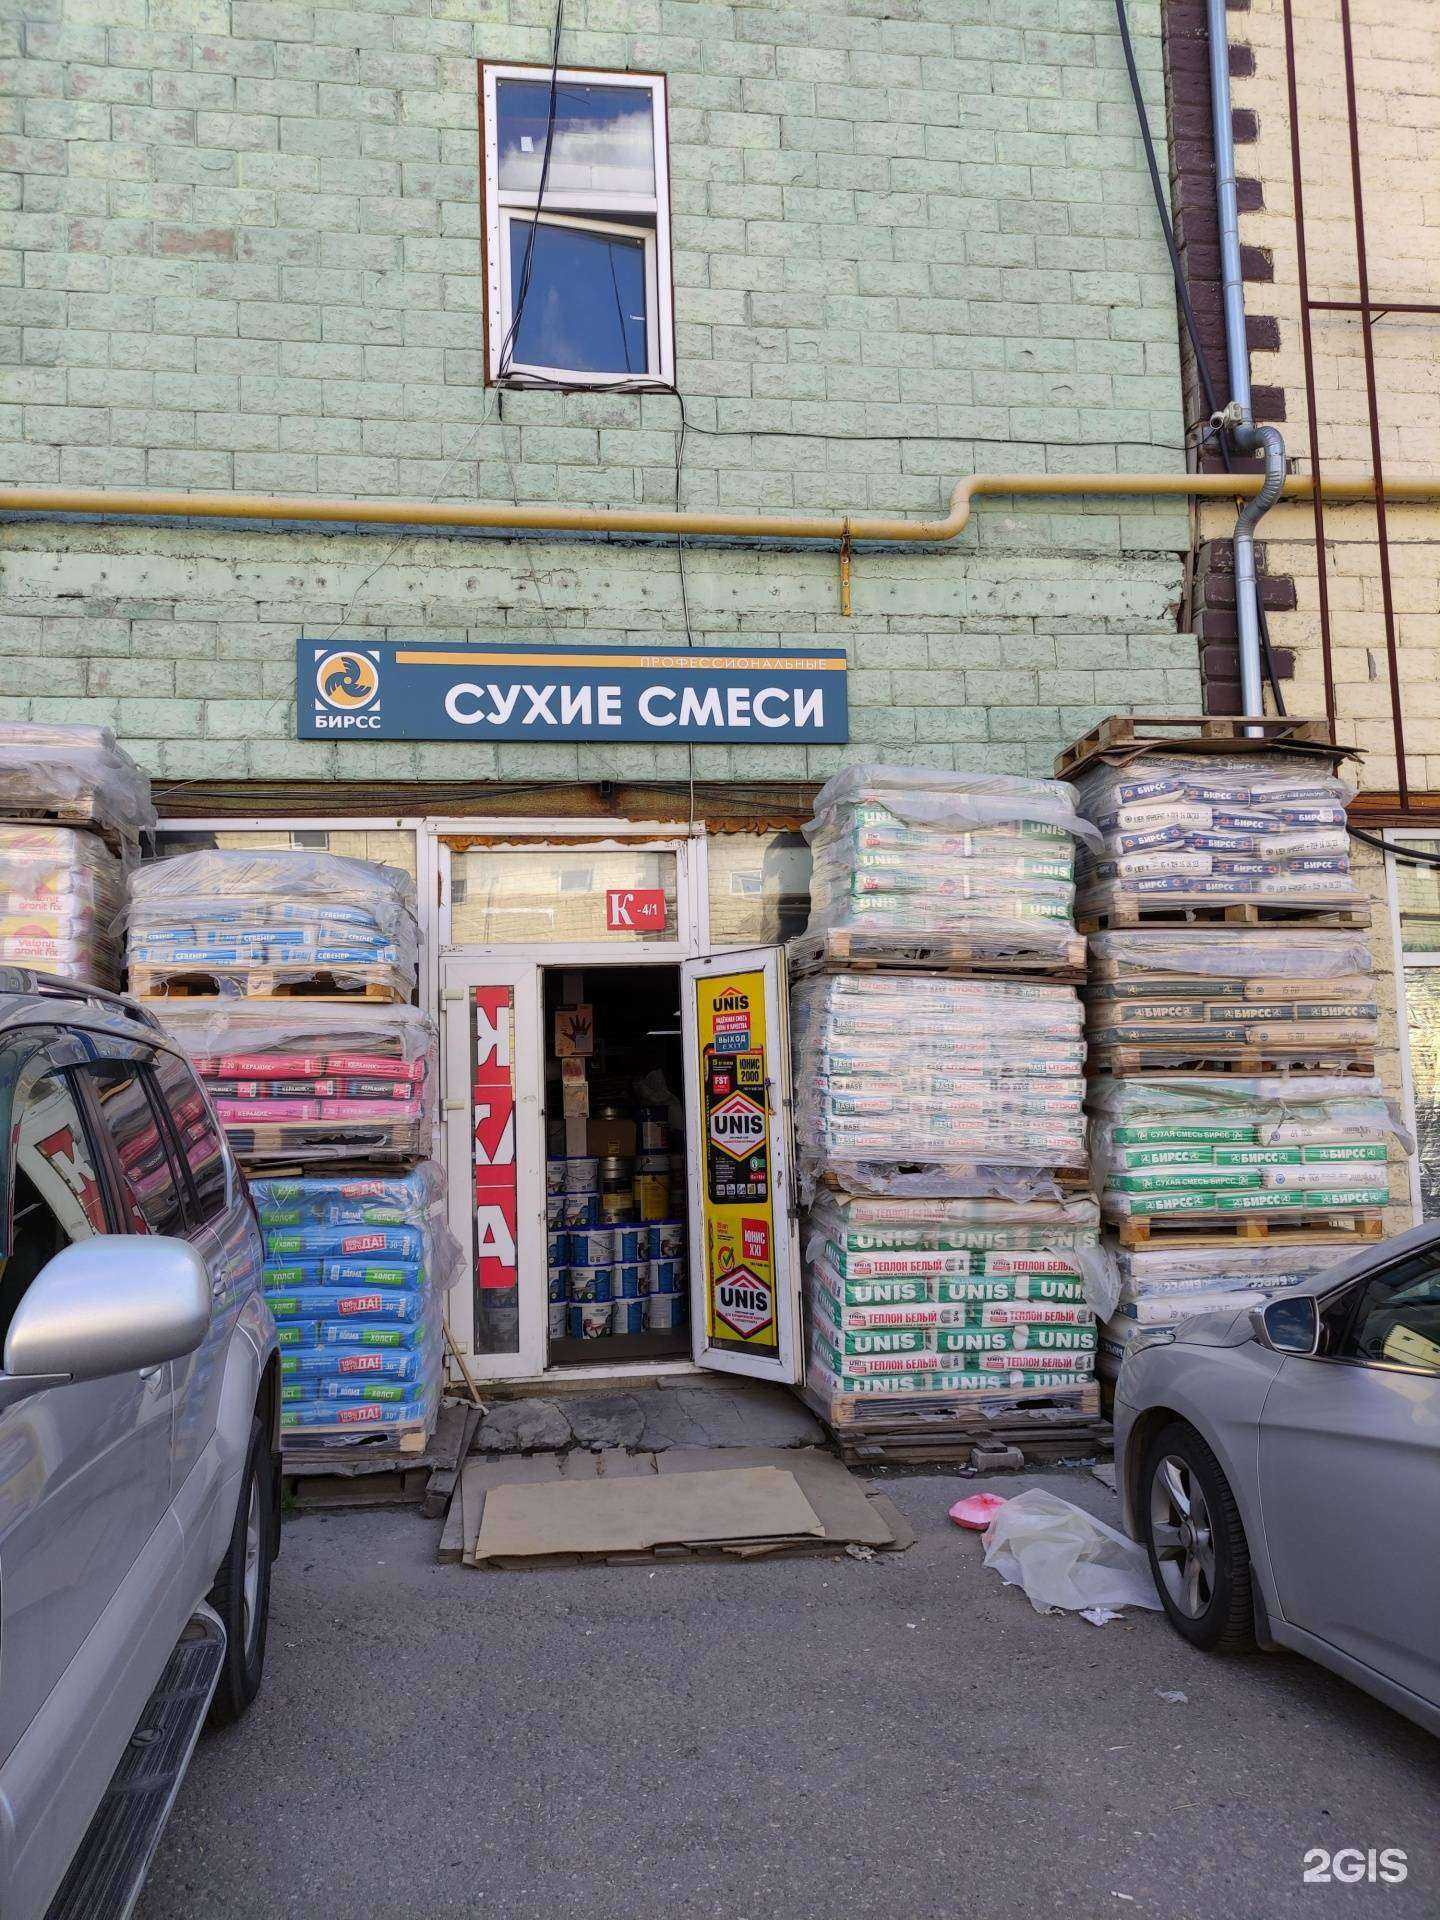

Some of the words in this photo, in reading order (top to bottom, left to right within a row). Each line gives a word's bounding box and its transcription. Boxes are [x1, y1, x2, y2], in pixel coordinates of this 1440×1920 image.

[640, 655, 827, 670] ПРОФЕССИОНАЛЬНЫЕ
[444, 683, 622, 726] СУХИЕ
[638, 685, 824, 728] СМЕСИ
[315, 715, 381, 729] БИРСС
[1137, 783, 1166, 794] БИРСС
[1204, 791, 1231, 800] БИРСС
[1234, 819, 1264, 828] БИРСС
[1298, 814, 1322, 822] БИРС
[1138, 832, 1167, 845] БИРСС
[1209, 840, 1236, 848] БИРСС
[1233, 865, 1263, 873] БИРСС
[1304, 861, 1332, 869] БИРСС
[1139, 880, 1167, 889] БИРСС
[713, 995, 749, 1012] UNIS
[1144, 1007, 1182, 1017] БИРСС
[1234, 1009, 1272, 1018] БИРСС
[1321, 1008, 1358, 1016] БИРСС
[718, 1034, 746, 1044] ВЫХОД
[739, 1058, 760, 1070] ЮНИС
[714, 1076, 728, 1085] FST
[741, 1071, 759, 1082] 2000
[714, 1115, 763, 1134] UNIS
[1151, 1151, 1189, 1162] БИРСС
[1241, 1153, 1278, 1162] БИРСС
[1330, 1148, 1367, 1158] БИРСС
[1155, 1198, 1194, 1209] БИРСС
[1242, 1195, 1280, 1206] БИРСС
[1331, 1192, 1369, 1204] БИРСС
[361, 1236, 384, 1250] ДА!
[744, 1230, 766, 1244] ЮНИС
[948, 1232, 1008, 1248] UNIS
[874, 1261, 908, 1272] ТЕПЛОН
[910, 1258, 942, 1270] БЕЛЫЙ
[1012, 1260, 1044, 1271] ТЕПЛОН
[854, 1284, 916, 1303] UNIS
[949, 1284, 1008, 1300] UNIS
[358, 1297, 379, 1310] ДА!
[720, 1287, 768, 1312] UNIS
[868, 1312, 903, 1324] ТЕПЛОН
[905, 1311, 937, 1323] БЕЛЫЙ
[1010, 1311, 1042, 1322] ТЕПЛОН
[1044, 1310, 1074, 1322] БЕЛЫЙ
[370, 1334, 394, 1343] ХОЛСТ
[854, 1334, 916, 1352] UNIS
[947, 1334, 1007, 1350] UNIS
[1038, 1331, 1094, 1349] UNIS
[358, 1357, 379, 1370] ДА!
[869, 1360, 903, 1371] ТЕПЛОН
[906, 1358, 938, 1370] БЕЛЫЙ
[1007, 1356, 1041, 1368] ТЕПЛОН
[1042, 1356, 1072, 1368] БЕЛЫЙ
[853, 1378, 914, 1392] UNIS
[941, 1376, 1000, 1391] UNIS
[358, 1406, 379, 1420] ДА!
